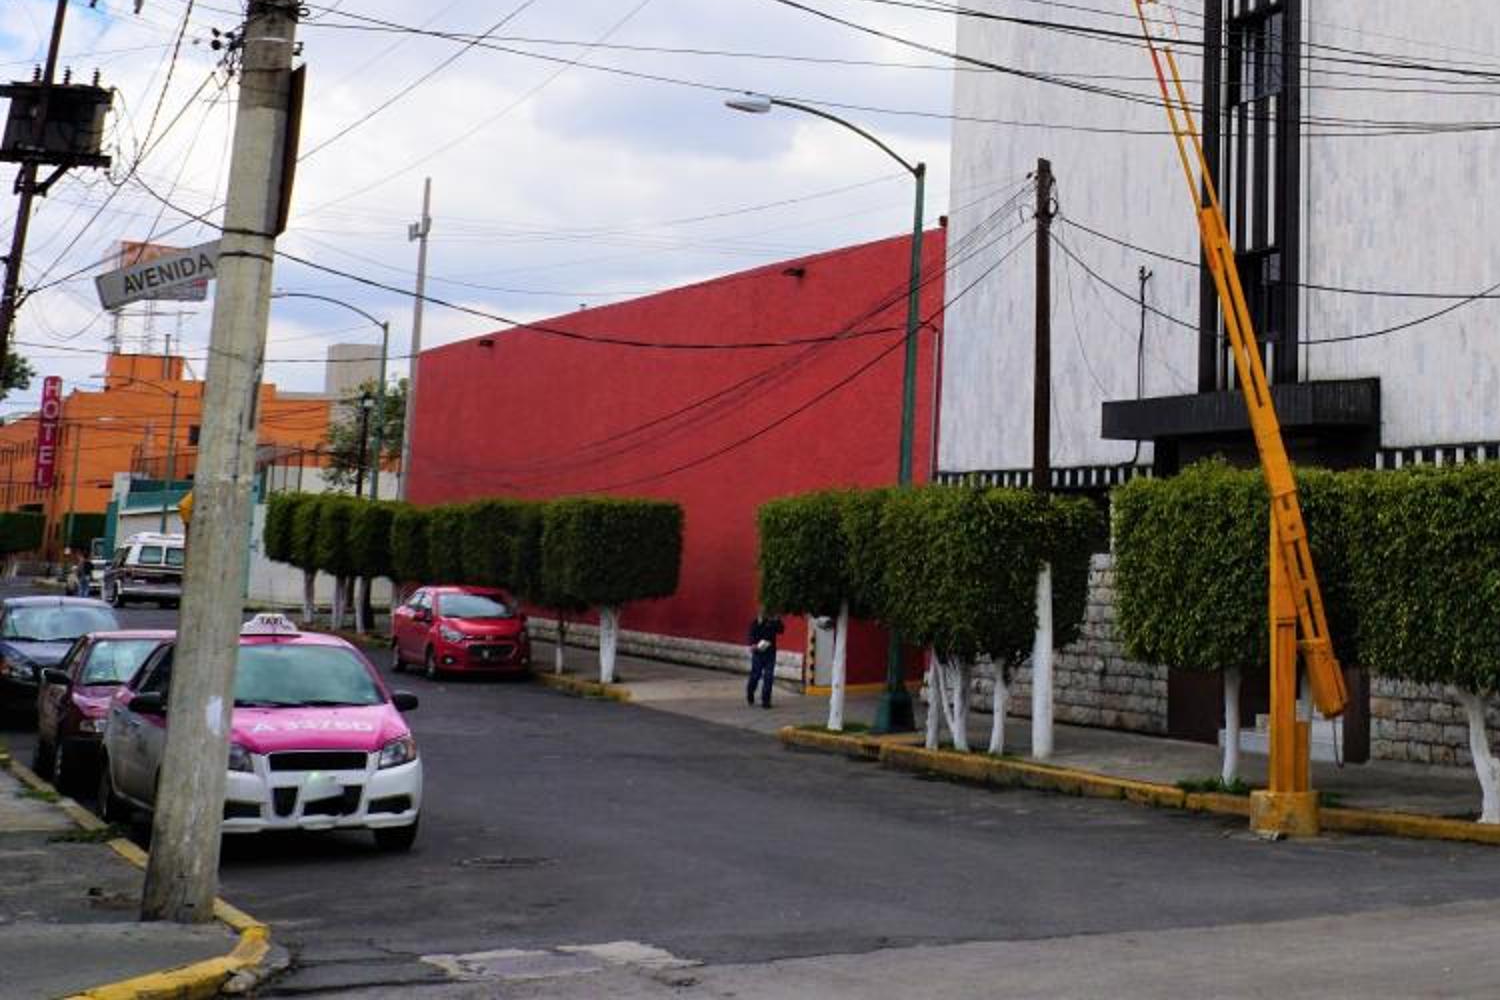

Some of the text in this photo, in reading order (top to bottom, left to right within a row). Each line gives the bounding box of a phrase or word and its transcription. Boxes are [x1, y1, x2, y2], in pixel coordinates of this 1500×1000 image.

[124, 253, 214, 294] AVENIDA
[38, 379, 61, 487] HOTEL
[259, 616, 283, 625] TAXI
